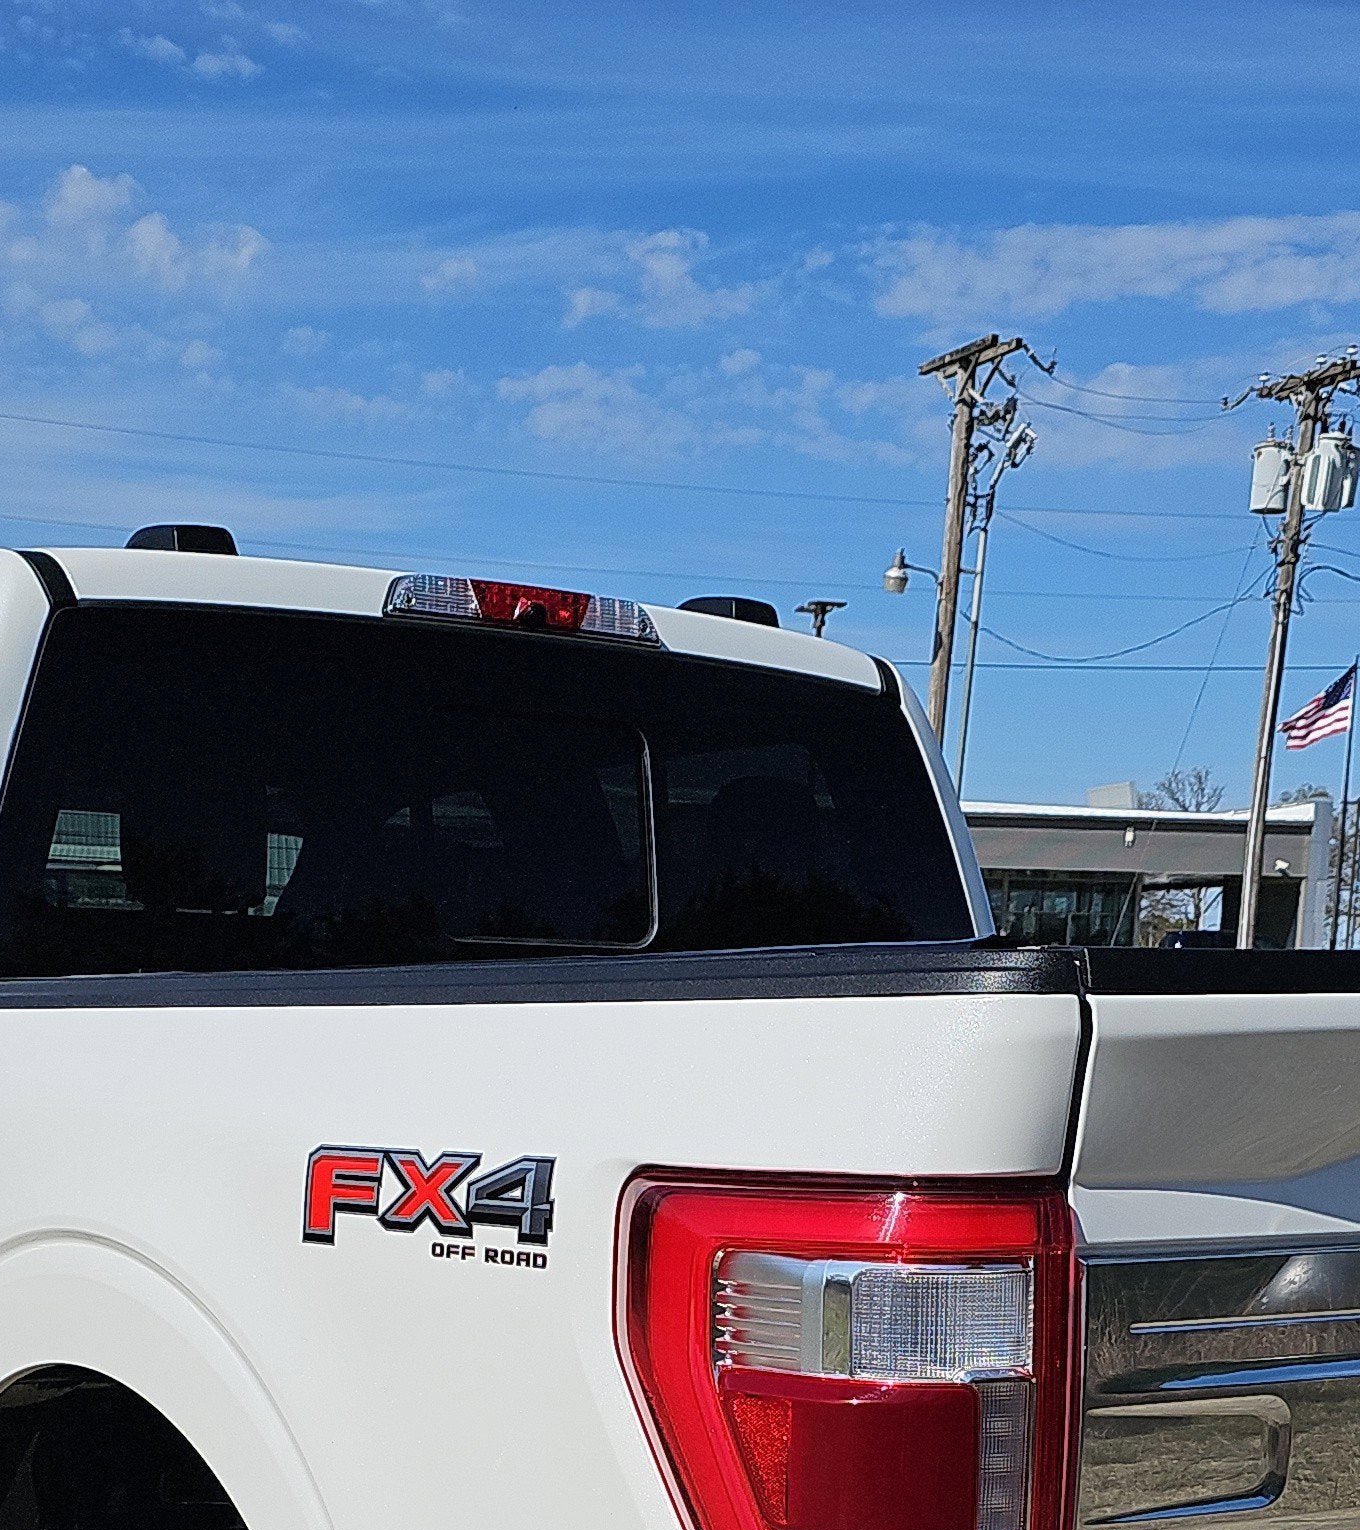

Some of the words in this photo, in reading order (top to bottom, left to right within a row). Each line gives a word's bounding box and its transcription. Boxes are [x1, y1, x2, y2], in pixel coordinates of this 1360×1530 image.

[301, 1144, 557, 1246] FX4
[430, 1241, 476, 1261] OFF
[484, 1247, 548, 1269] ROAD
